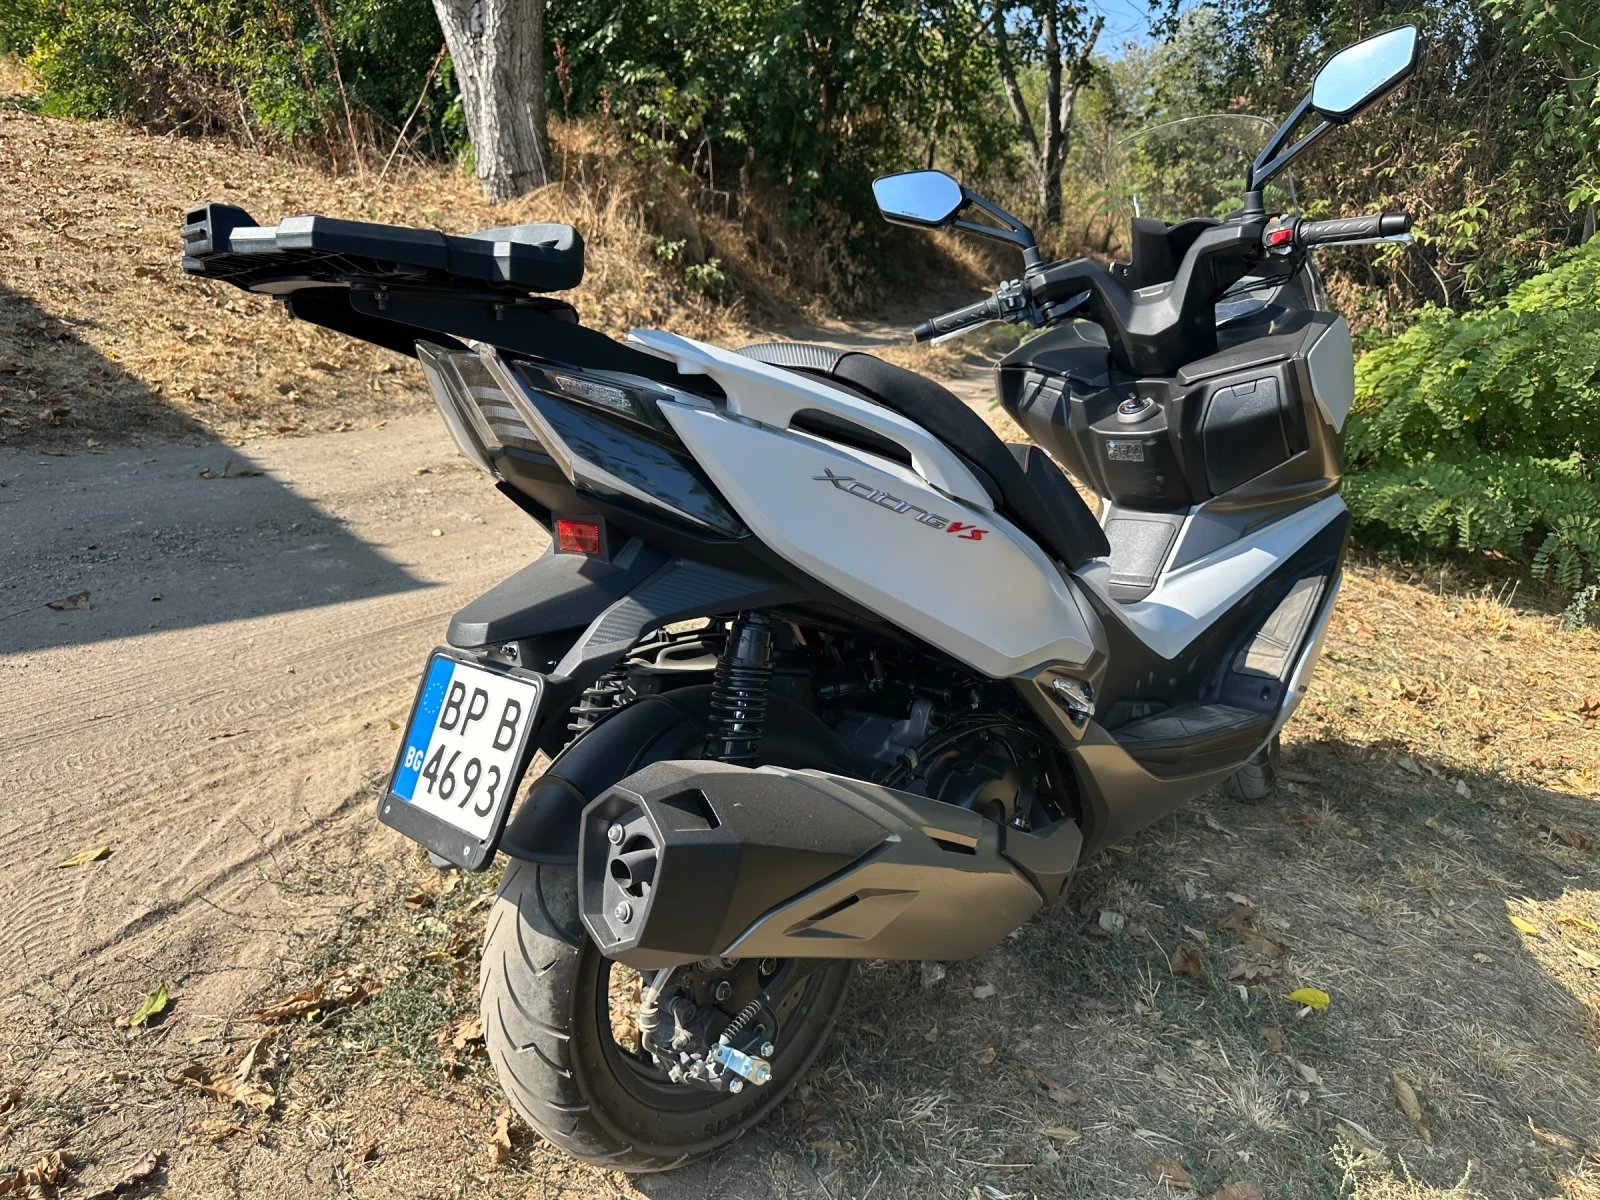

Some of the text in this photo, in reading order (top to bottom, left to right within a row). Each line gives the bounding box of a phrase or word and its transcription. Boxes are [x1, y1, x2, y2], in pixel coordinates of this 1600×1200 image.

[946, 522, 989, 541] VS
[438, 680, 522, 752] BP B
[404, 746, 423, 772] BG
[422, 744, 501, 818] 4693
